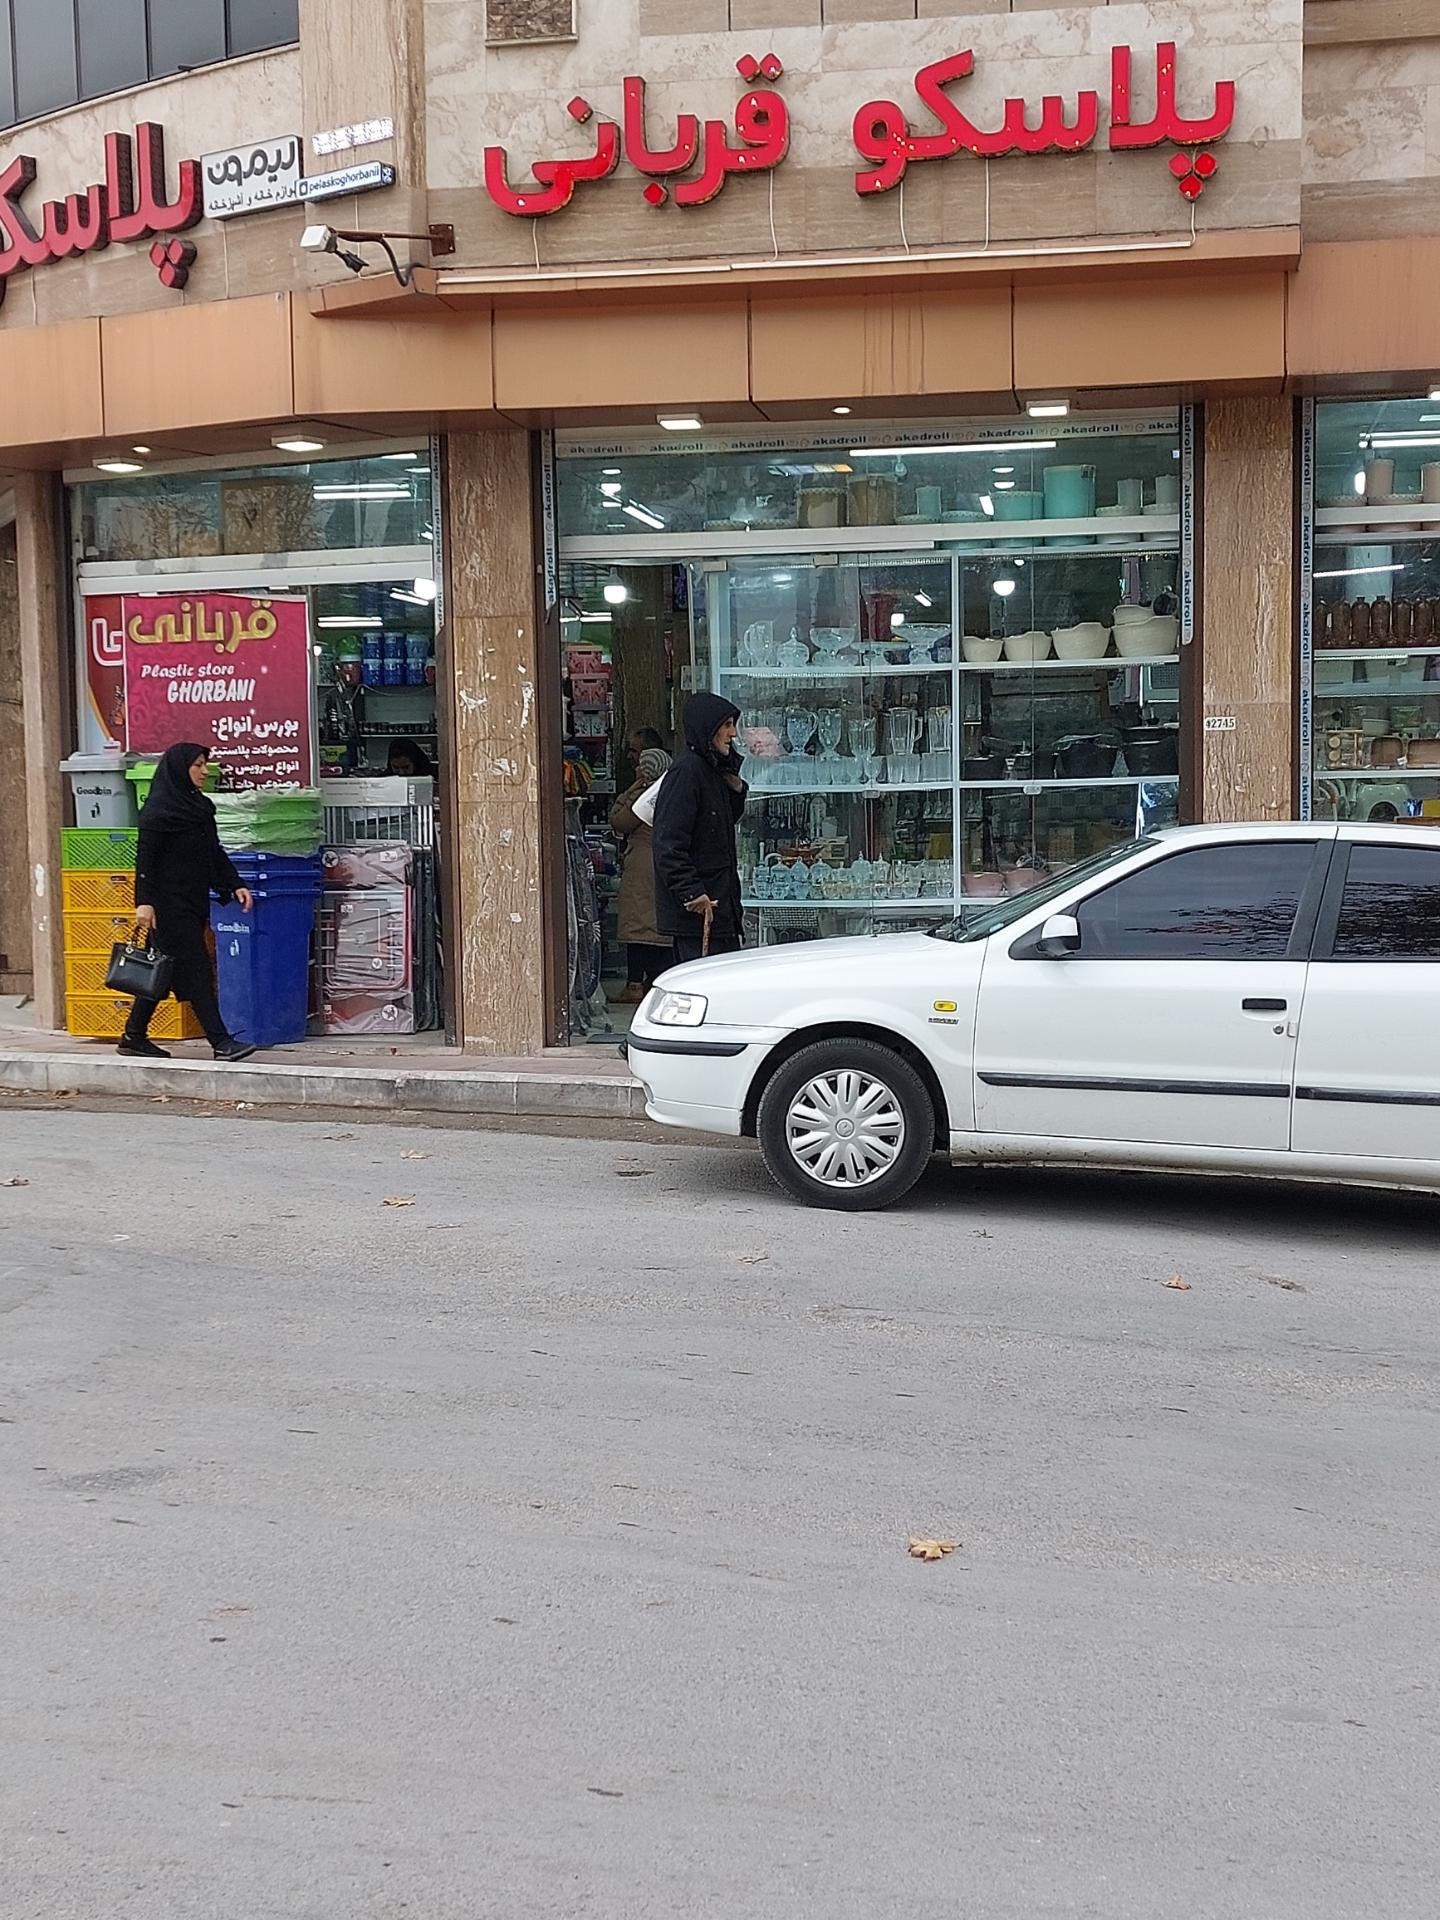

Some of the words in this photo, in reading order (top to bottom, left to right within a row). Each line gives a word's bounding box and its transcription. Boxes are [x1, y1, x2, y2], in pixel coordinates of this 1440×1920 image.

[484, 52, 789, 217] قربانی
[853, 41, 1236, 202] پلاسکو
[1304, 428, 1312, 486] akadroll
[1184, 485, 1192, 541] akadroll
[1303, 516, 1311, 573] akadroll
[128, 600, 278, 654] قربانی
[1184, 571, 1192, 627] akadroll
[1303, 604, 1311, 660] akadroll
[141, 664, 194, 678] Plastic
[198, 663, 235, 677] store
[167, 679, 256, 704] GHORBANI
[254, 719, 299, 738] بورس
[1302, 690, 1310, 747] akadroll
[234, 764, 274, 775] سرویس
[251, 744, 299, 757] محصولات
[275, 761, 300, 776] انواع
